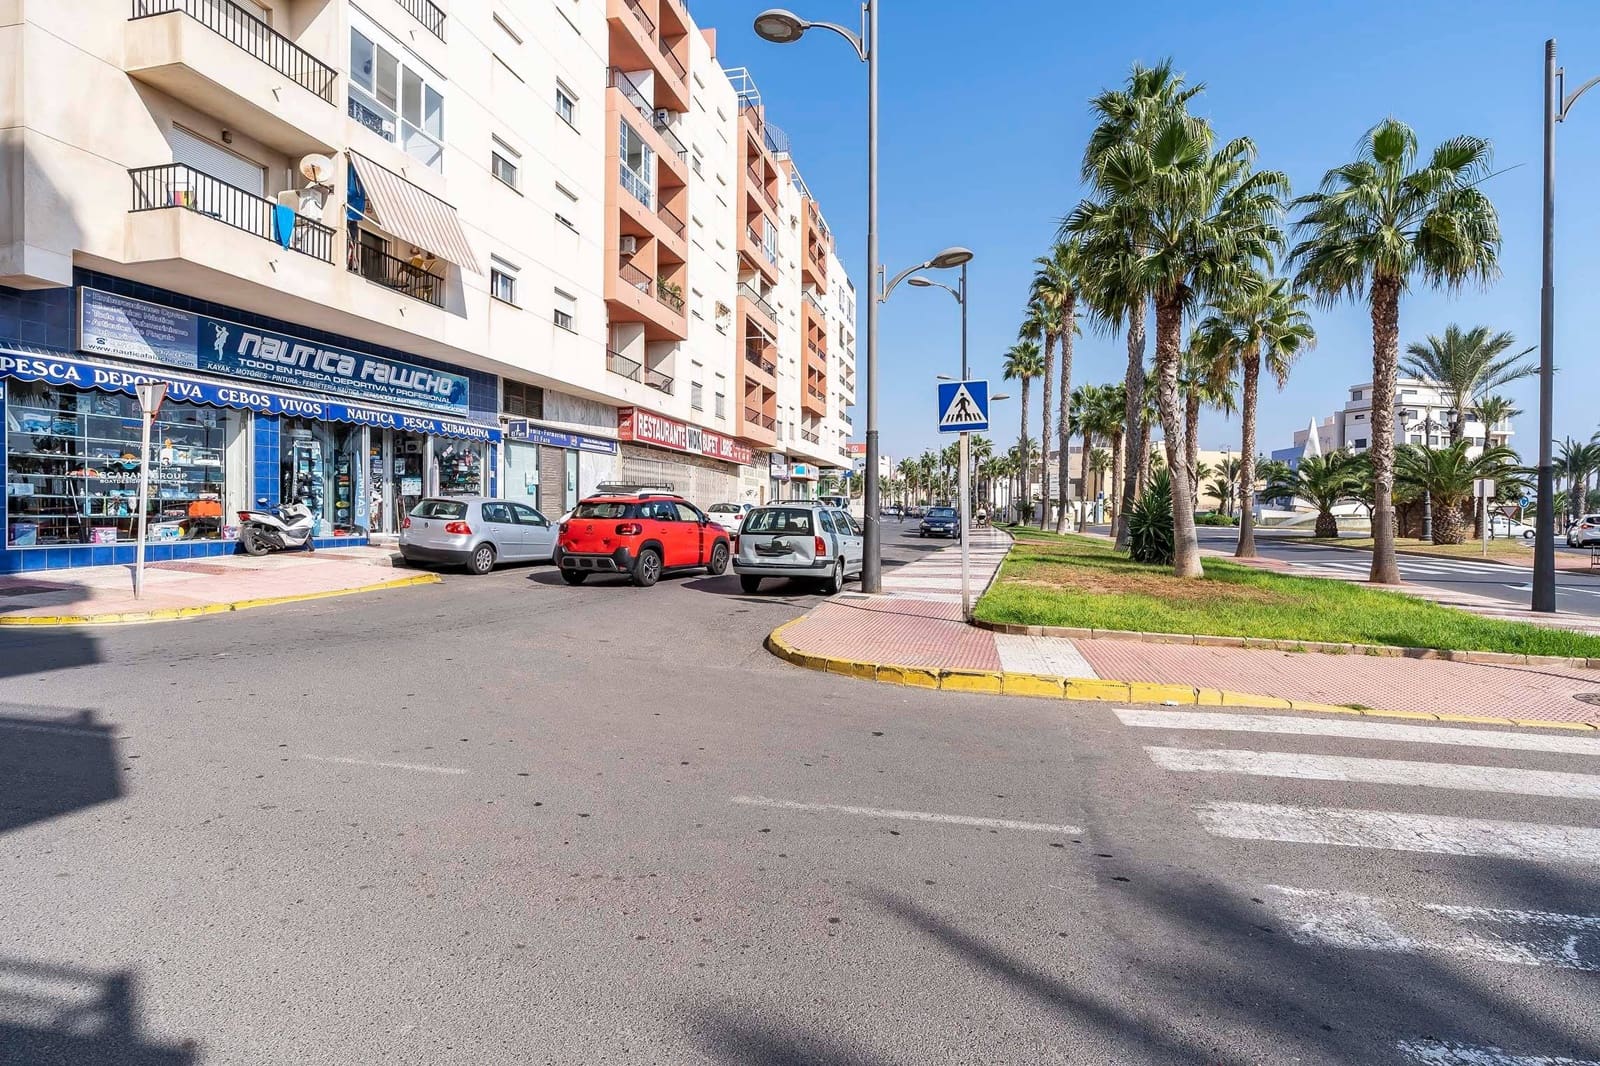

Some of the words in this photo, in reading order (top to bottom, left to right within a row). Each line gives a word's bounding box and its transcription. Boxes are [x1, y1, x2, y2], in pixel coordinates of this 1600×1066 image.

[0, 356, 81, 381] PESCA
[217, 389, 272, 407] CEBOS
[278, 398, 323, 414] VIVOS
[207, 363, 231, 373] KAYAK
[235, 368, 267, 379] MOTORES
[271, 374, 298, 384] PINTURA
[238, 358, 275, 372] TODO
[276, 366, 294, 376] EN
[294, 369, 332, 383] PESCA
[332, 376, 388, 393] DEPORTIVA
[388, 384, 395, 393] Y
[396, 387, 452, 403] PROFESIONAL
[346, 408, 396, 425] NAUTICA
[403, 416, 436, 431] PESCA
[441, 423, 490, 439] SUBMARINA
[638, 412, 686, 449] RESTAURANTE
[687, 427, 702, 451] WOK
[99, 471, 145, 480] SCARAN
